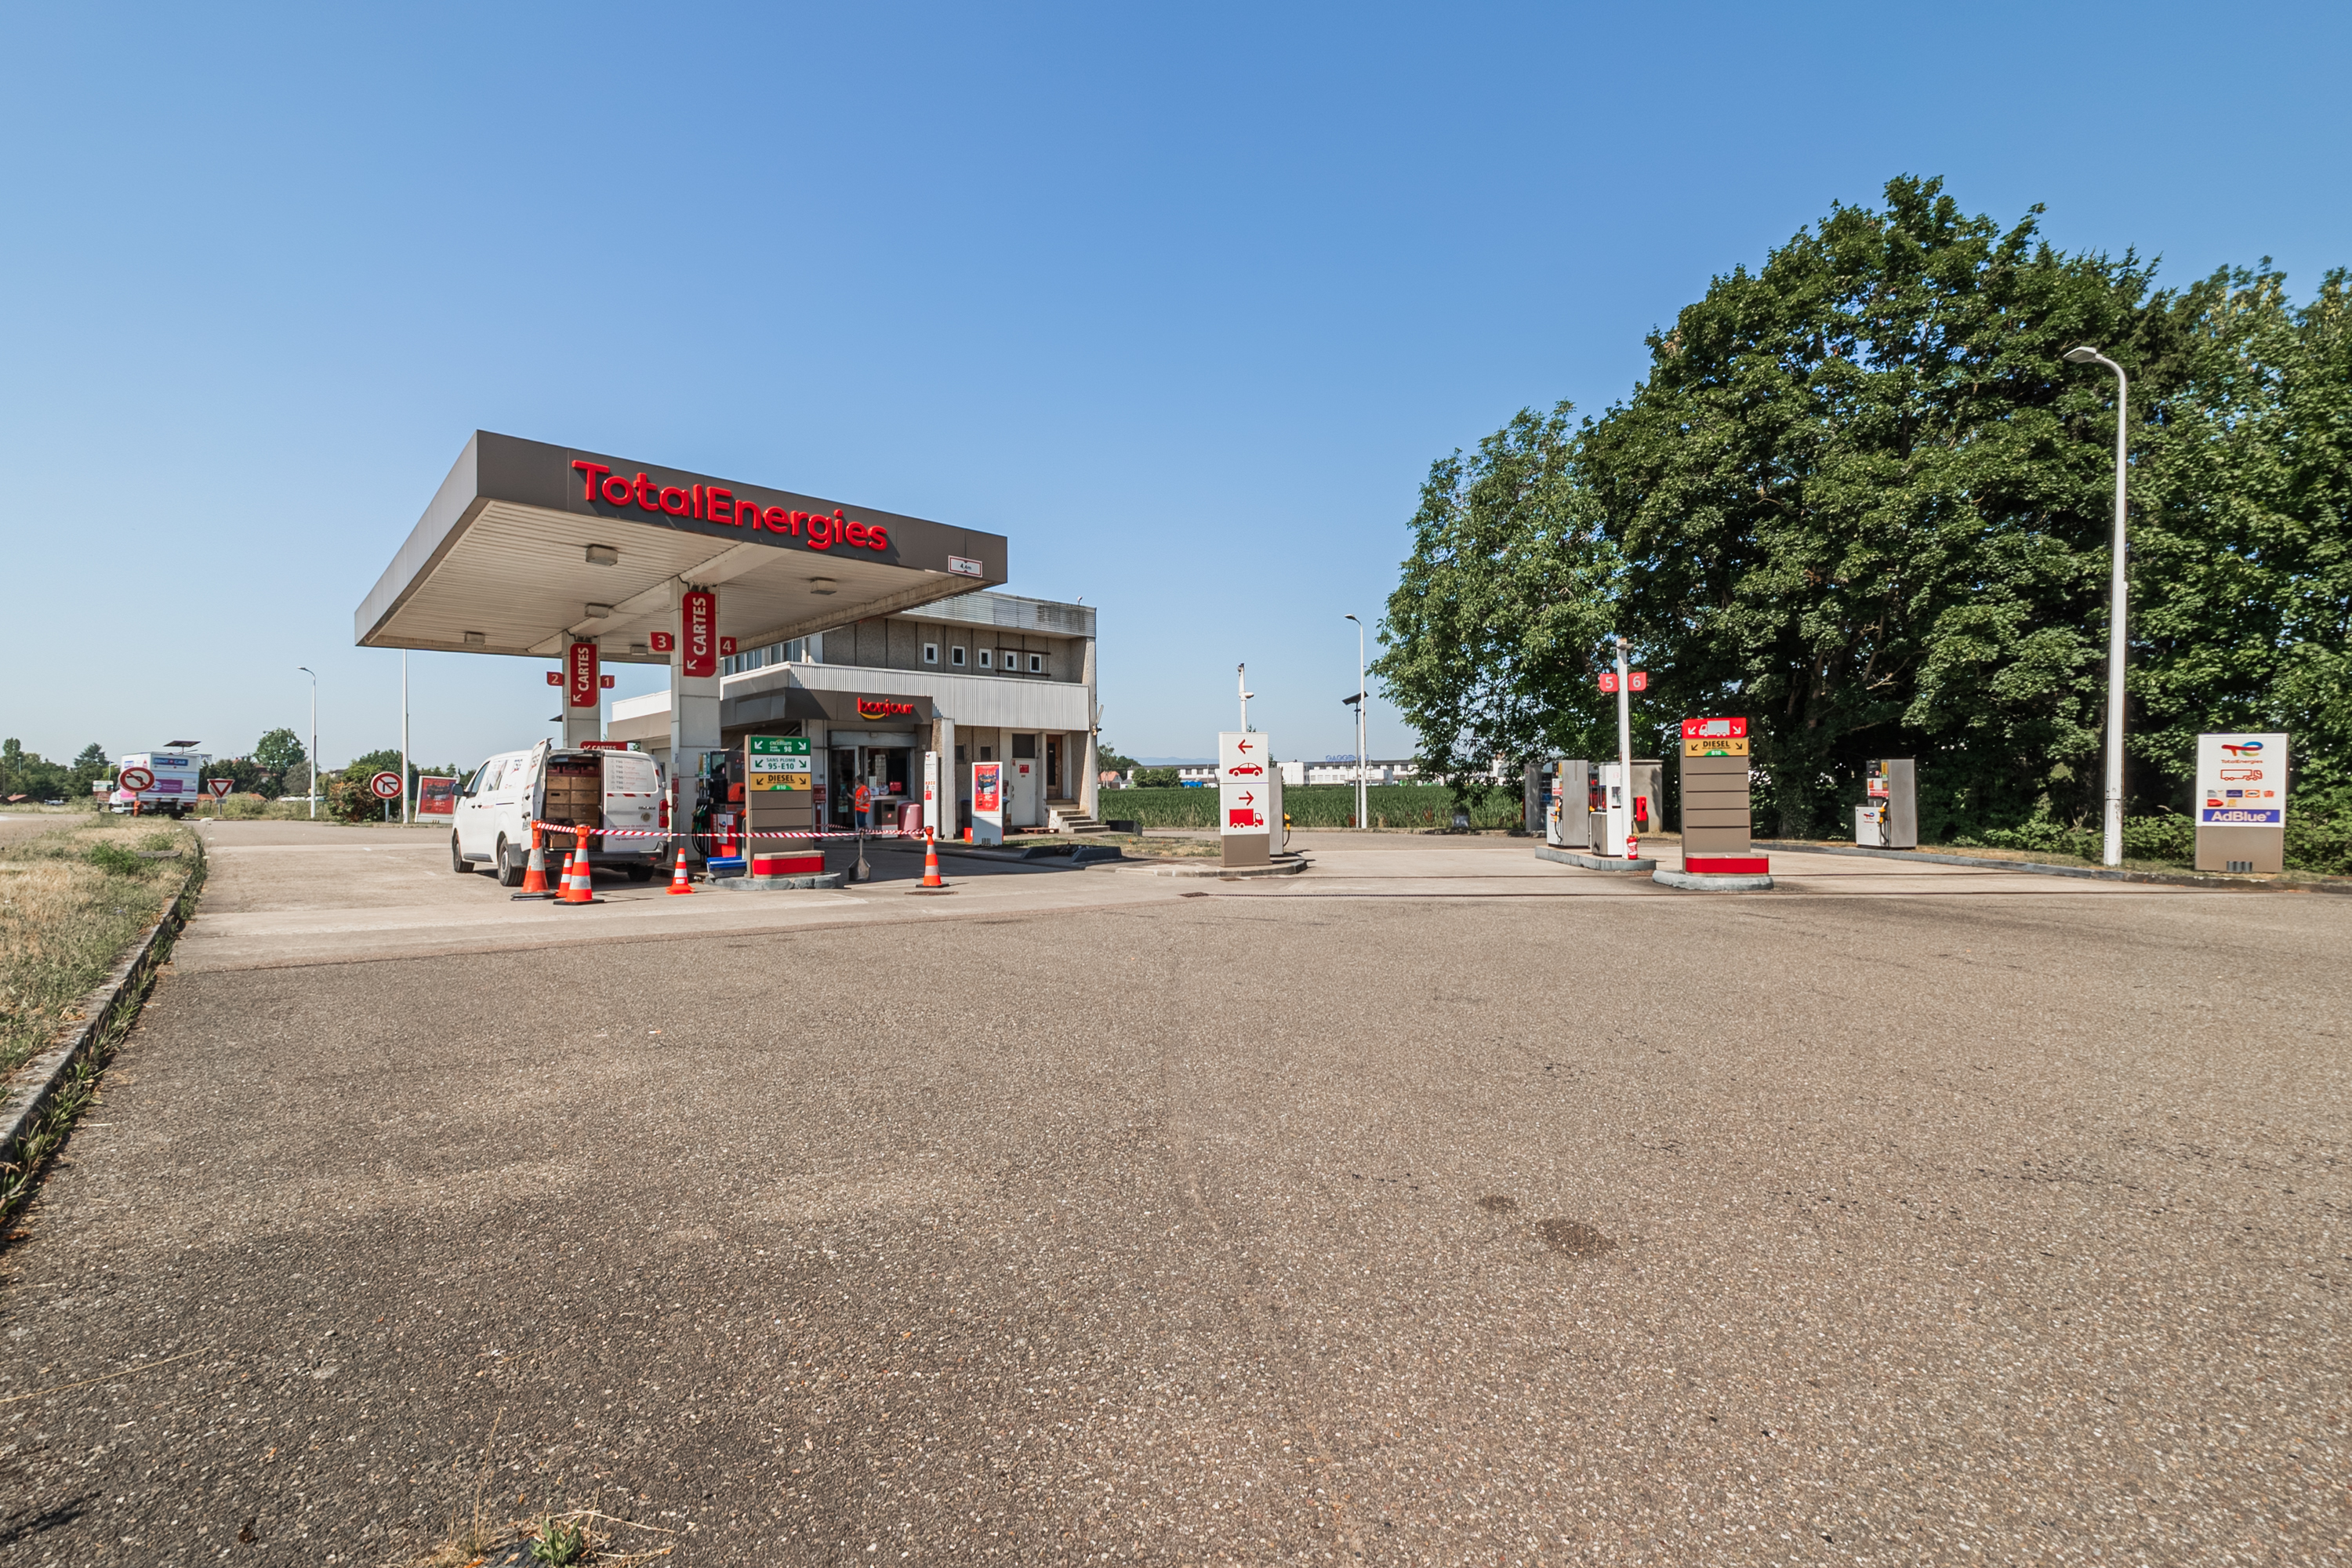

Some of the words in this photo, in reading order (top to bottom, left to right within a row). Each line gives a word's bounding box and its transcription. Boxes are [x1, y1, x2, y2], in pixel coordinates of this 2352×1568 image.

[572, 459, 887, 550] TotalEnergies
[692, 597, 707, 655] CARTES
[657, 635, 667, 648] 3
[722, 640, 732, 652] 4
[578, 647, 590, 691] CARTES
[551, 673, 560, 684] 2
[604, 677, 610, 687] 1
[1605, 676, 1613, 689] 5
[1632, 675, 1642, 688] 6
[857, 697, 914, 717] bonjour
